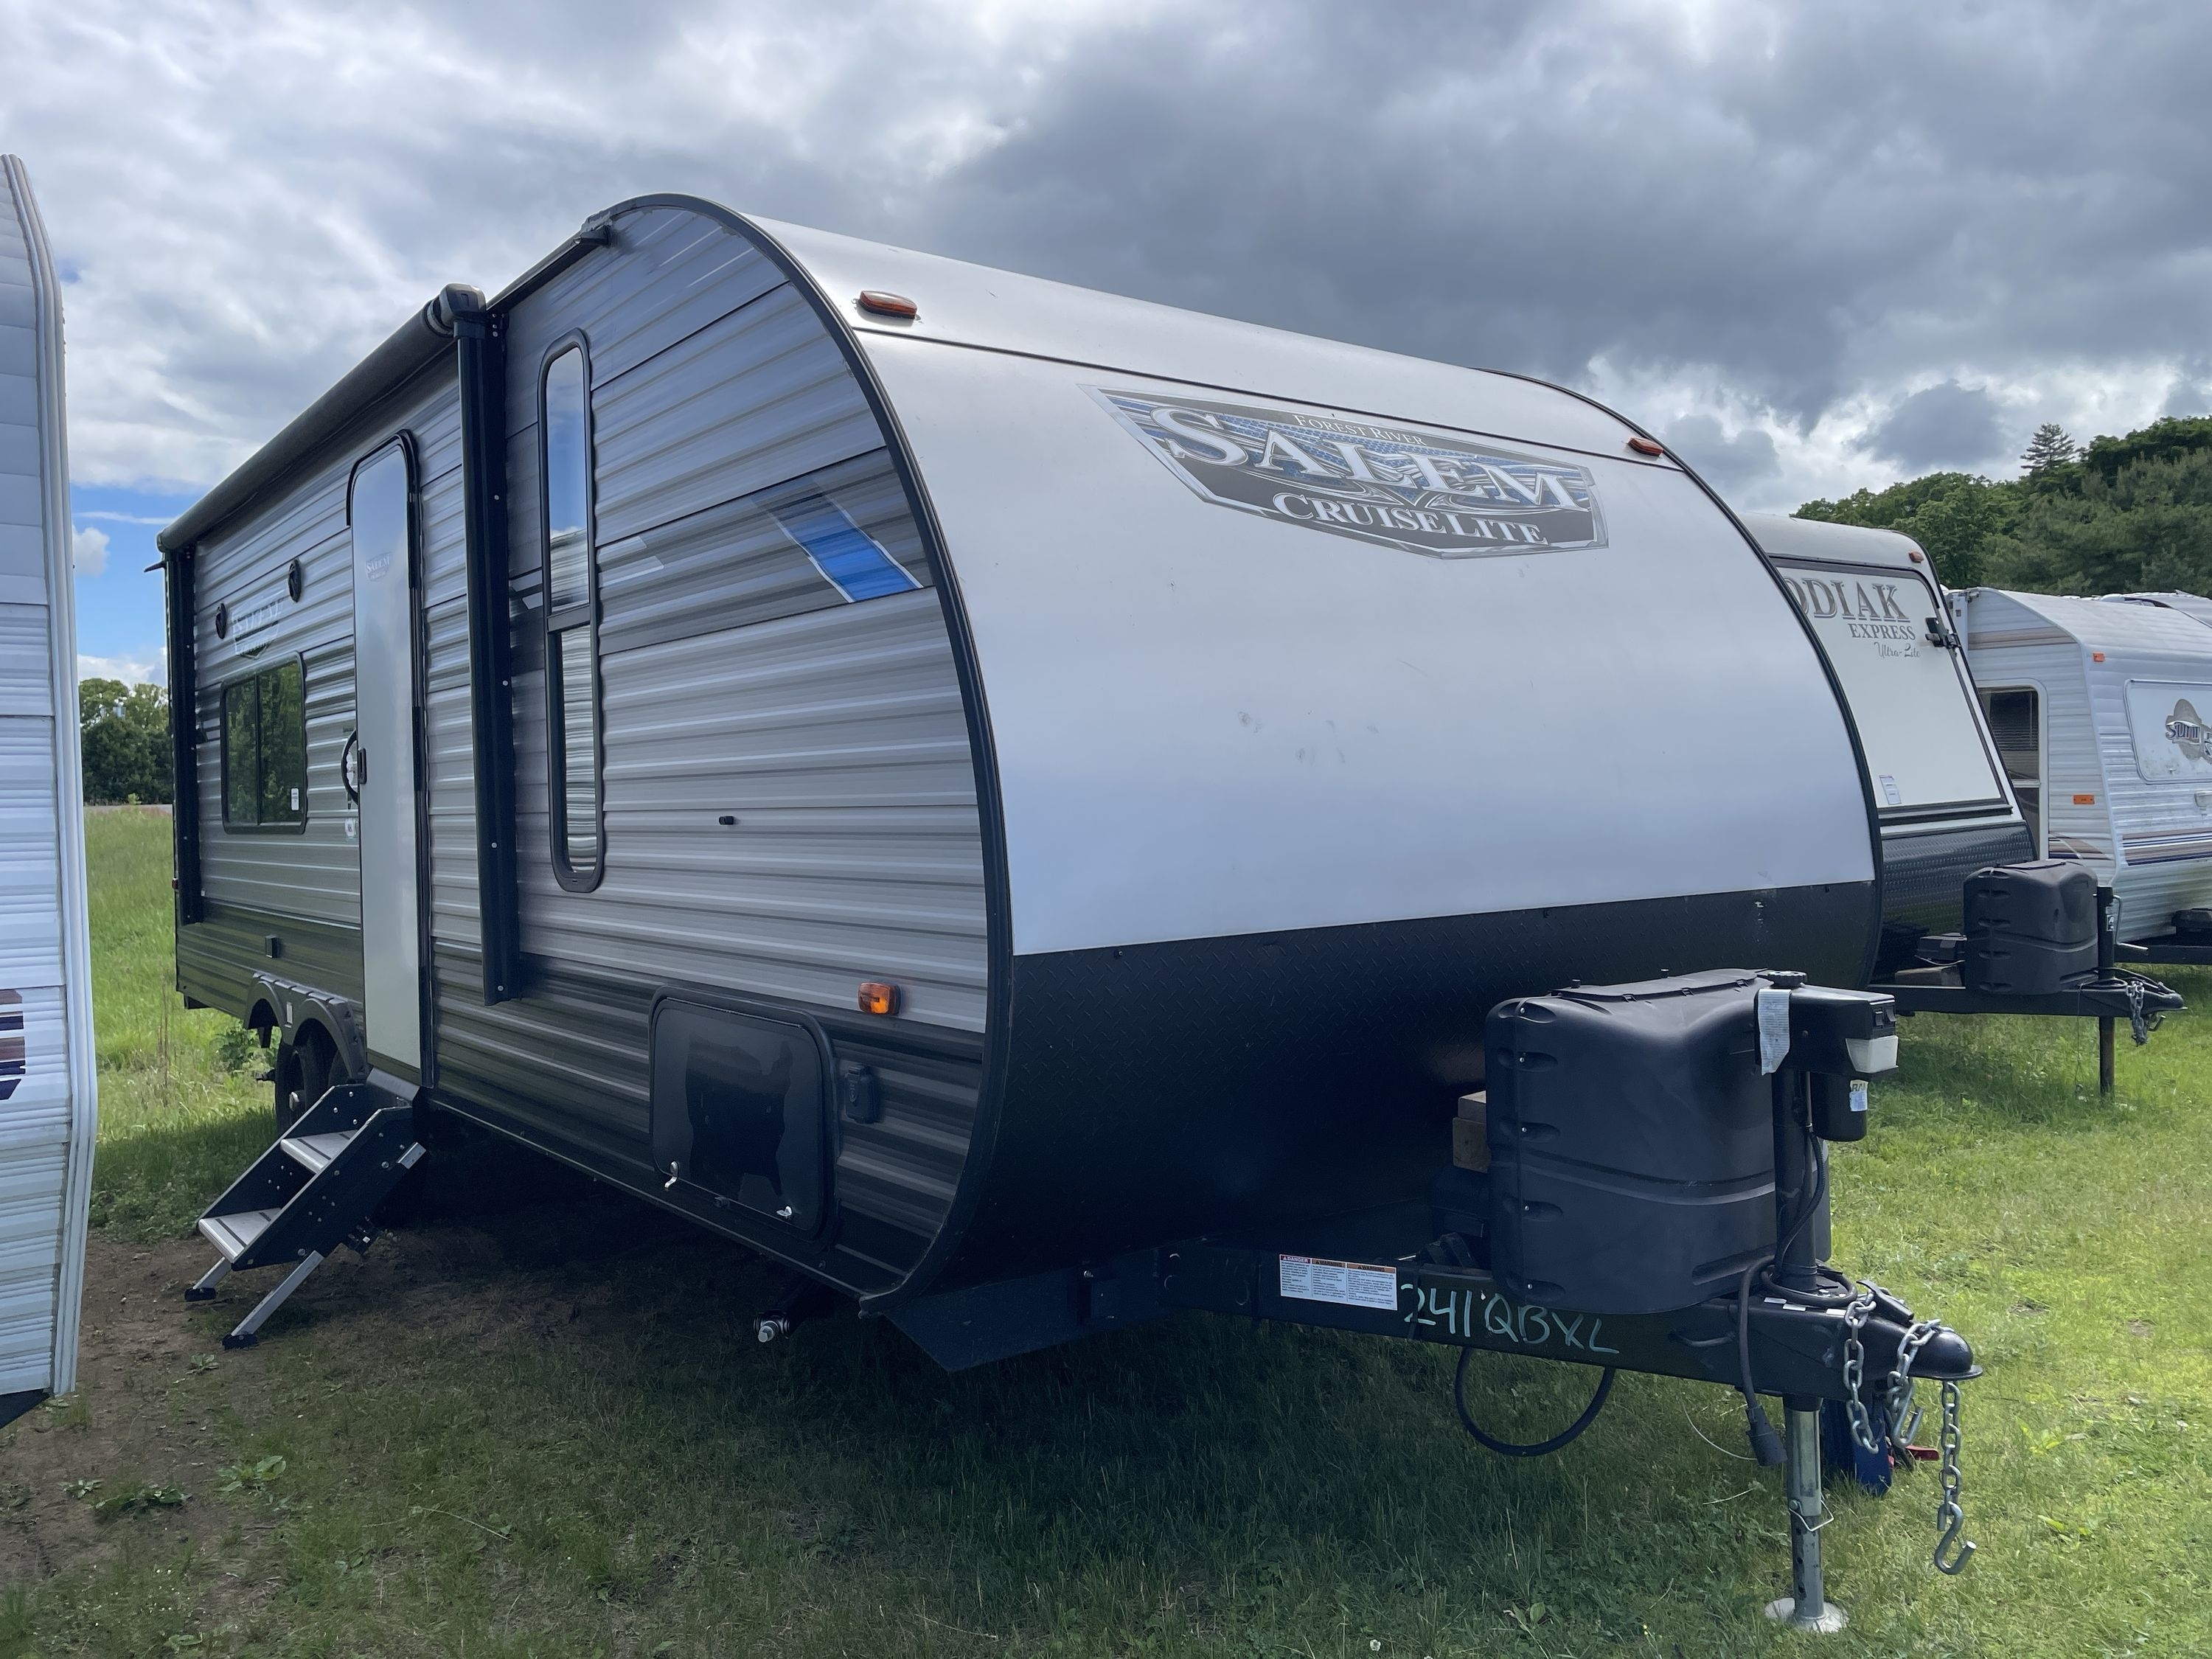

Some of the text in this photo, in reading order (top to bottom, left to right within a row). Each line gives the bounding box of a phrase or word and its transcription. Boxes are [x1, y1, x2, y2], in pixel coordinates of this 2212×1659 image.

[1292, 414, 1427, 446] FOREST RIVER
[1150, 406, 1592, 513] SALEM
[1848, 622, 1916, 641] EXPRESS
